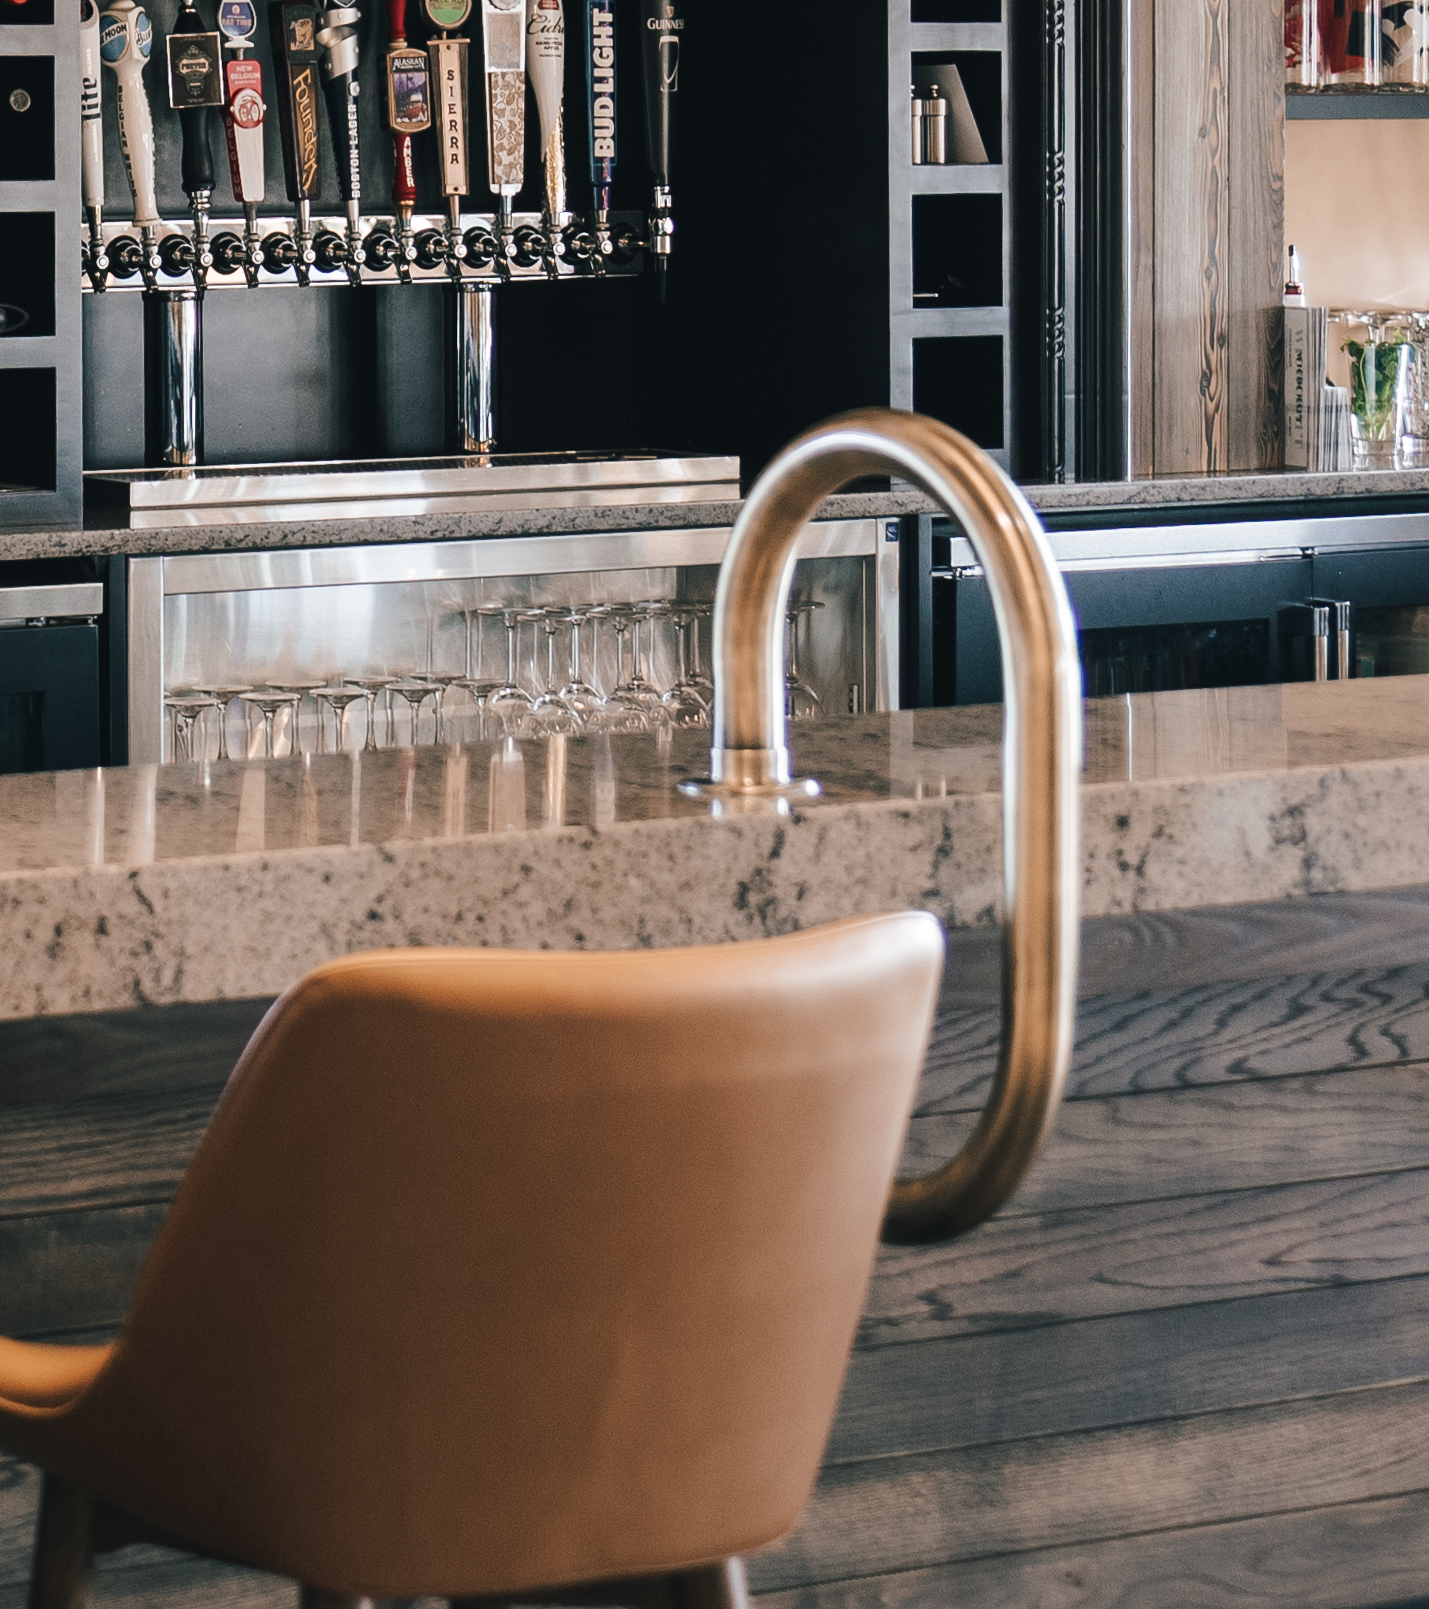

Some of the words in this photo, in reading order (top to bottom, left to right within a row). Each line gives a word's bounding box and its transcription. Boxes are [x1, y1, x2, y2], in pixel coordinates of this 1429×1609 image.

[103, 22, 128, 41] MOON
[647, 18, 685, 30] GUINNESS
[392, 56, 425, 71] ALASKAN
[593, 8, 614, 93] LIGHT
[347, 103, 358, 145] LAGER
[447, 70, 459, 165] SIERRA
[594, 97, 615, 158] BUD
[349, 149, 361, 198] BOSTON
[404, 136, 415, 188] AMBER
